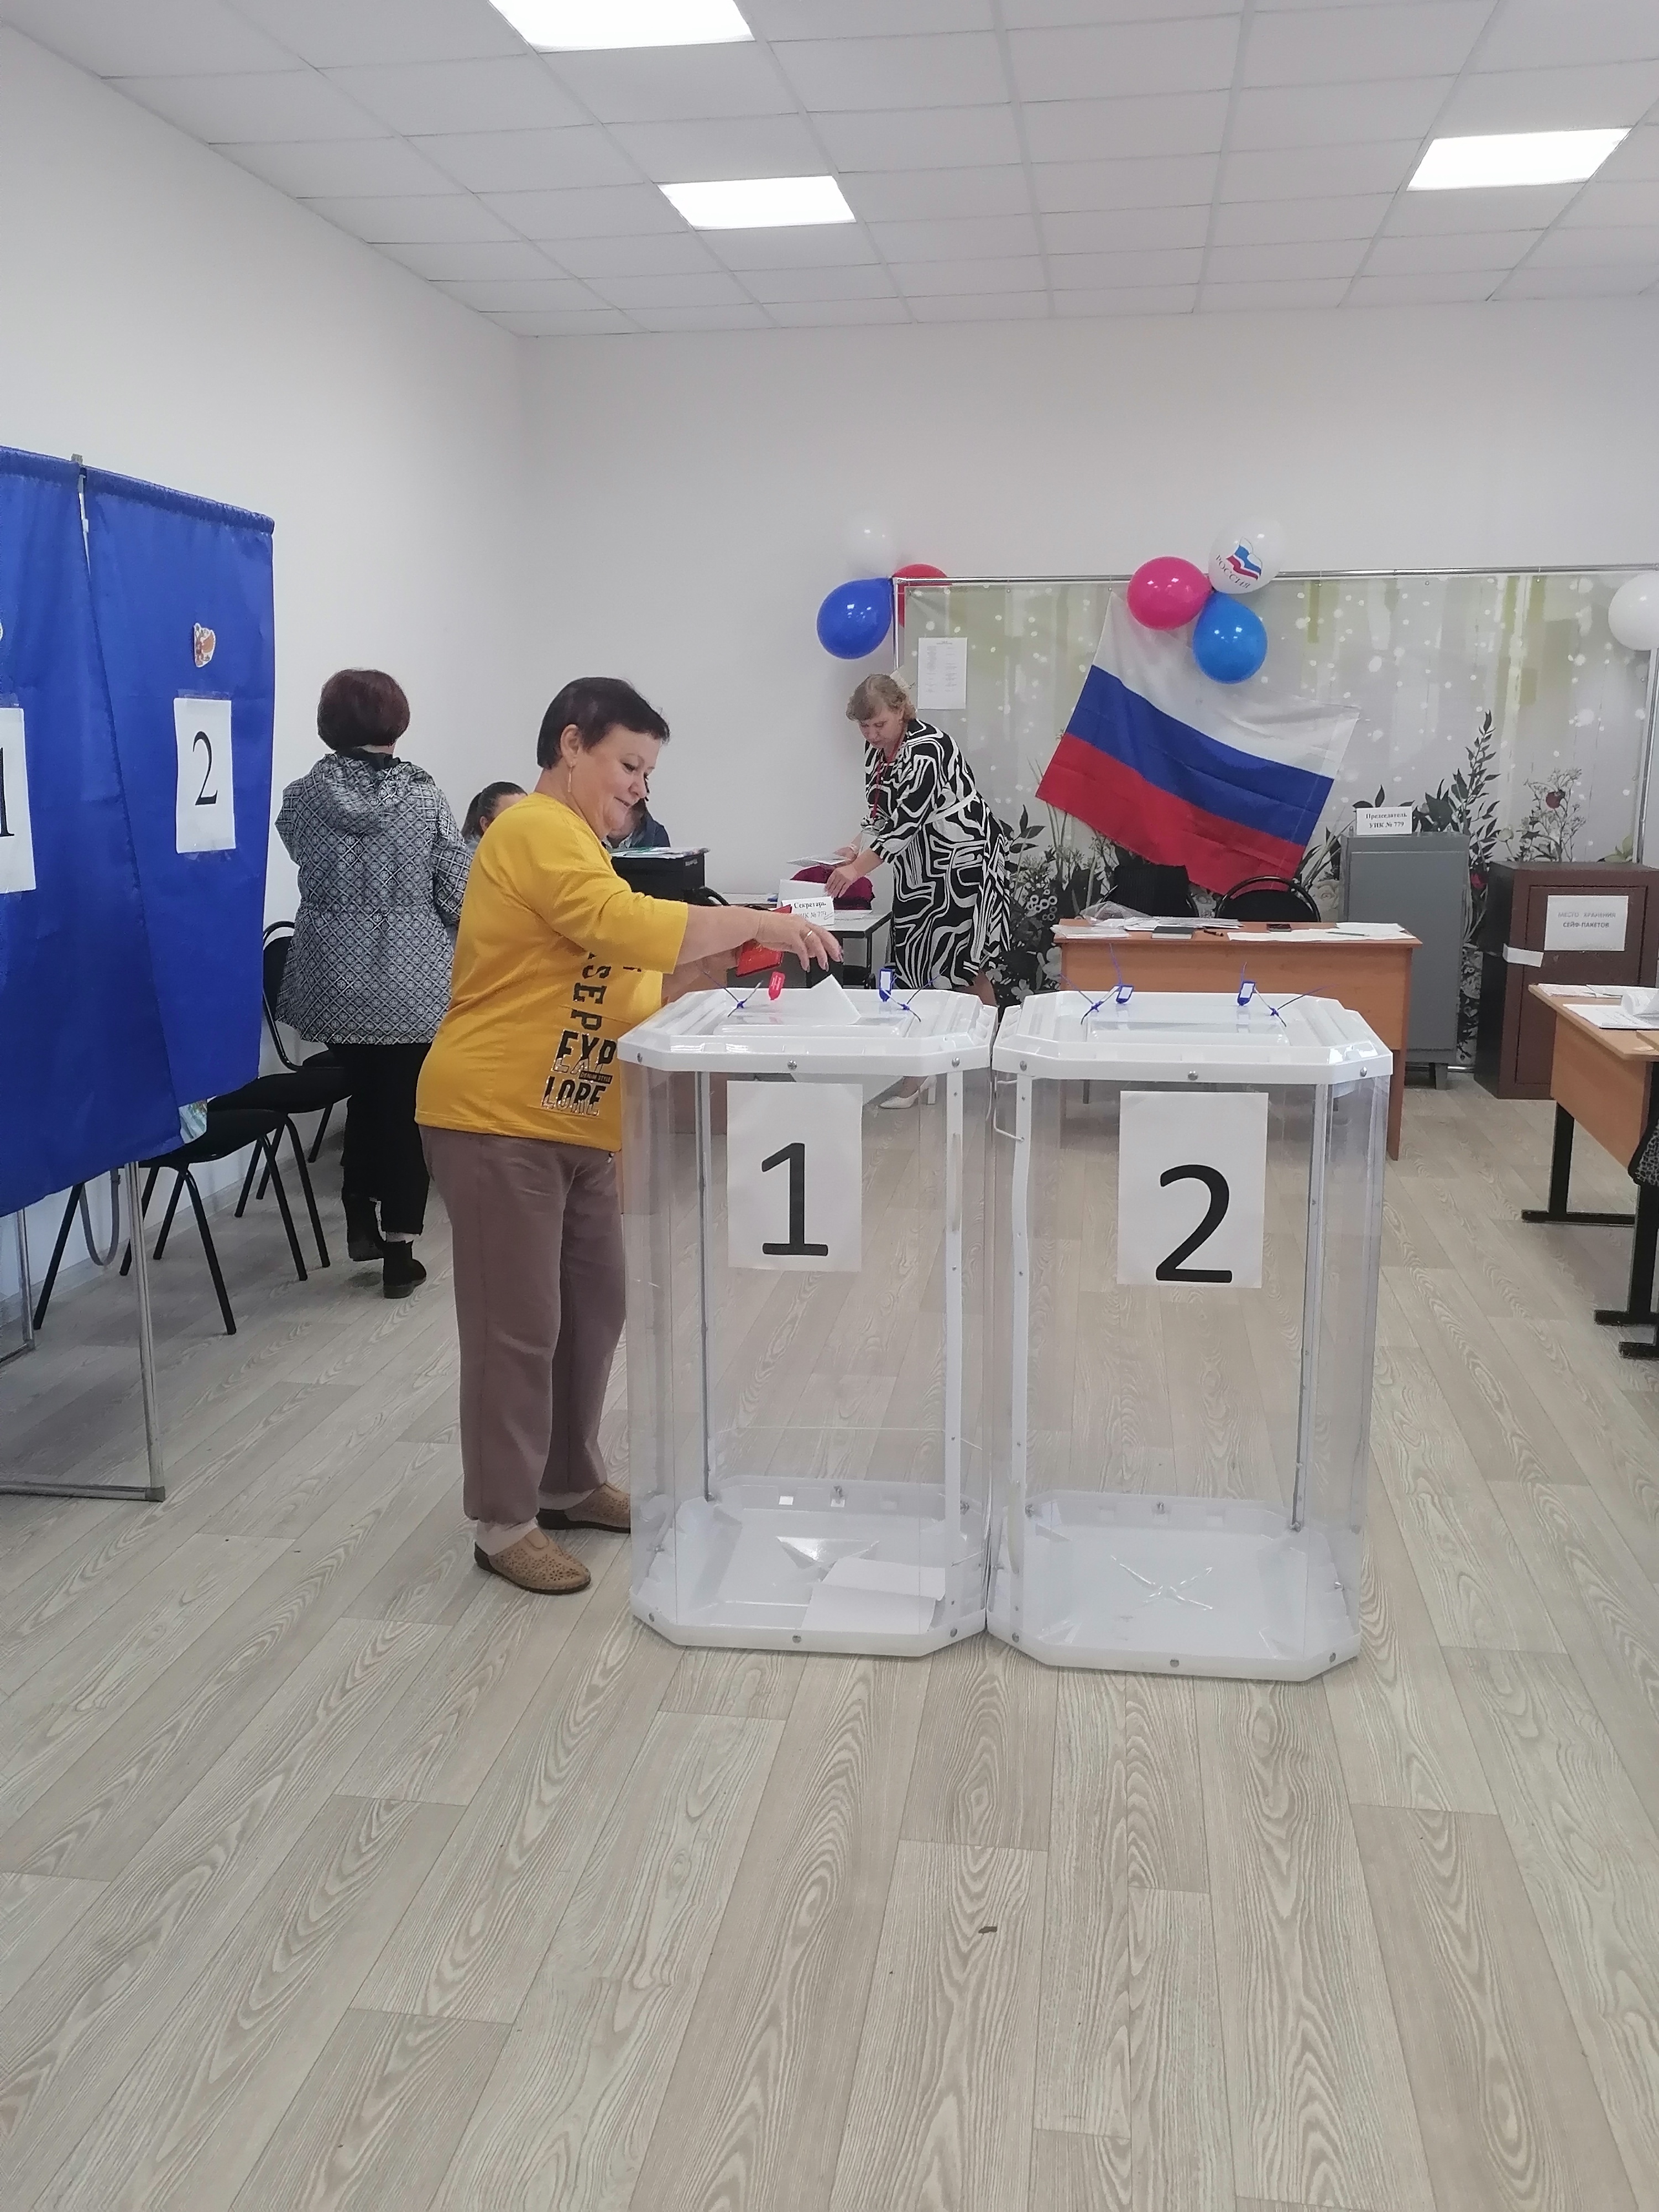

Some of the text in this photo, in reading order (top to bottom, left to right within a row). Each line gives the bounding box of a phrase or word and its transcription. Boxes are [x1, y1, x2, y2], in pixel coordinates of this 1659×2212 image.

[1215, 554, 1251, 588] РОССИЯ
[192, 731, 218, 805] 2
[761, 1142, 828, 1256] 1
[1155, 1164, 1233, 1283] 2
